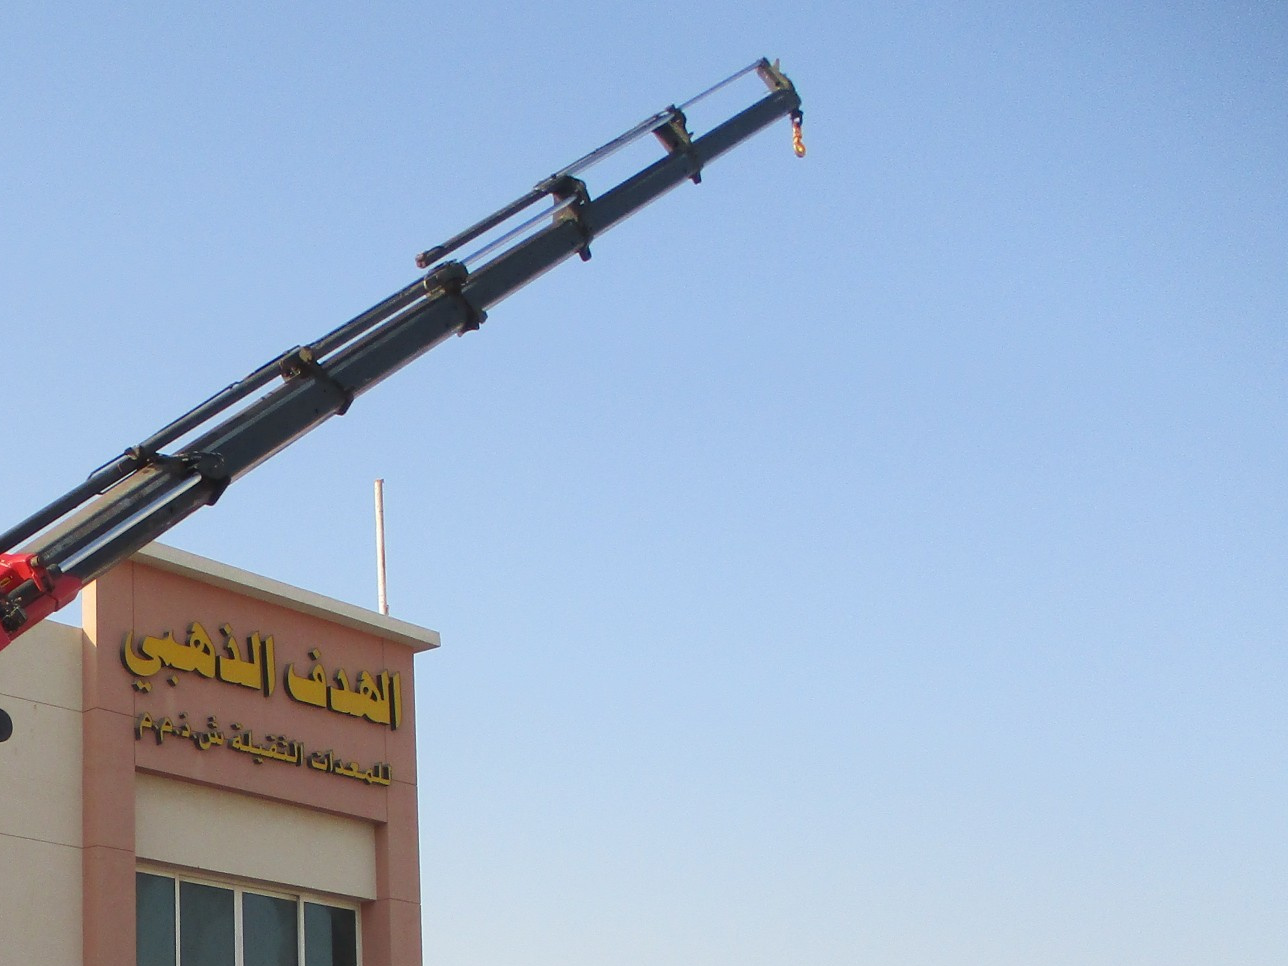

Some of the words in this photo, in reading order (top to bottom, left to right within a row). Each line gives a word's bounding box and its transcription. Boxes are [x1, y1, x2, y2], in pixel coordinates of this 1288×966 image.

[121, 621, 276, 698] الذهبي
[285, 648, 403, 731] الهدف
[307, 750, 392, 786] للمعدات
